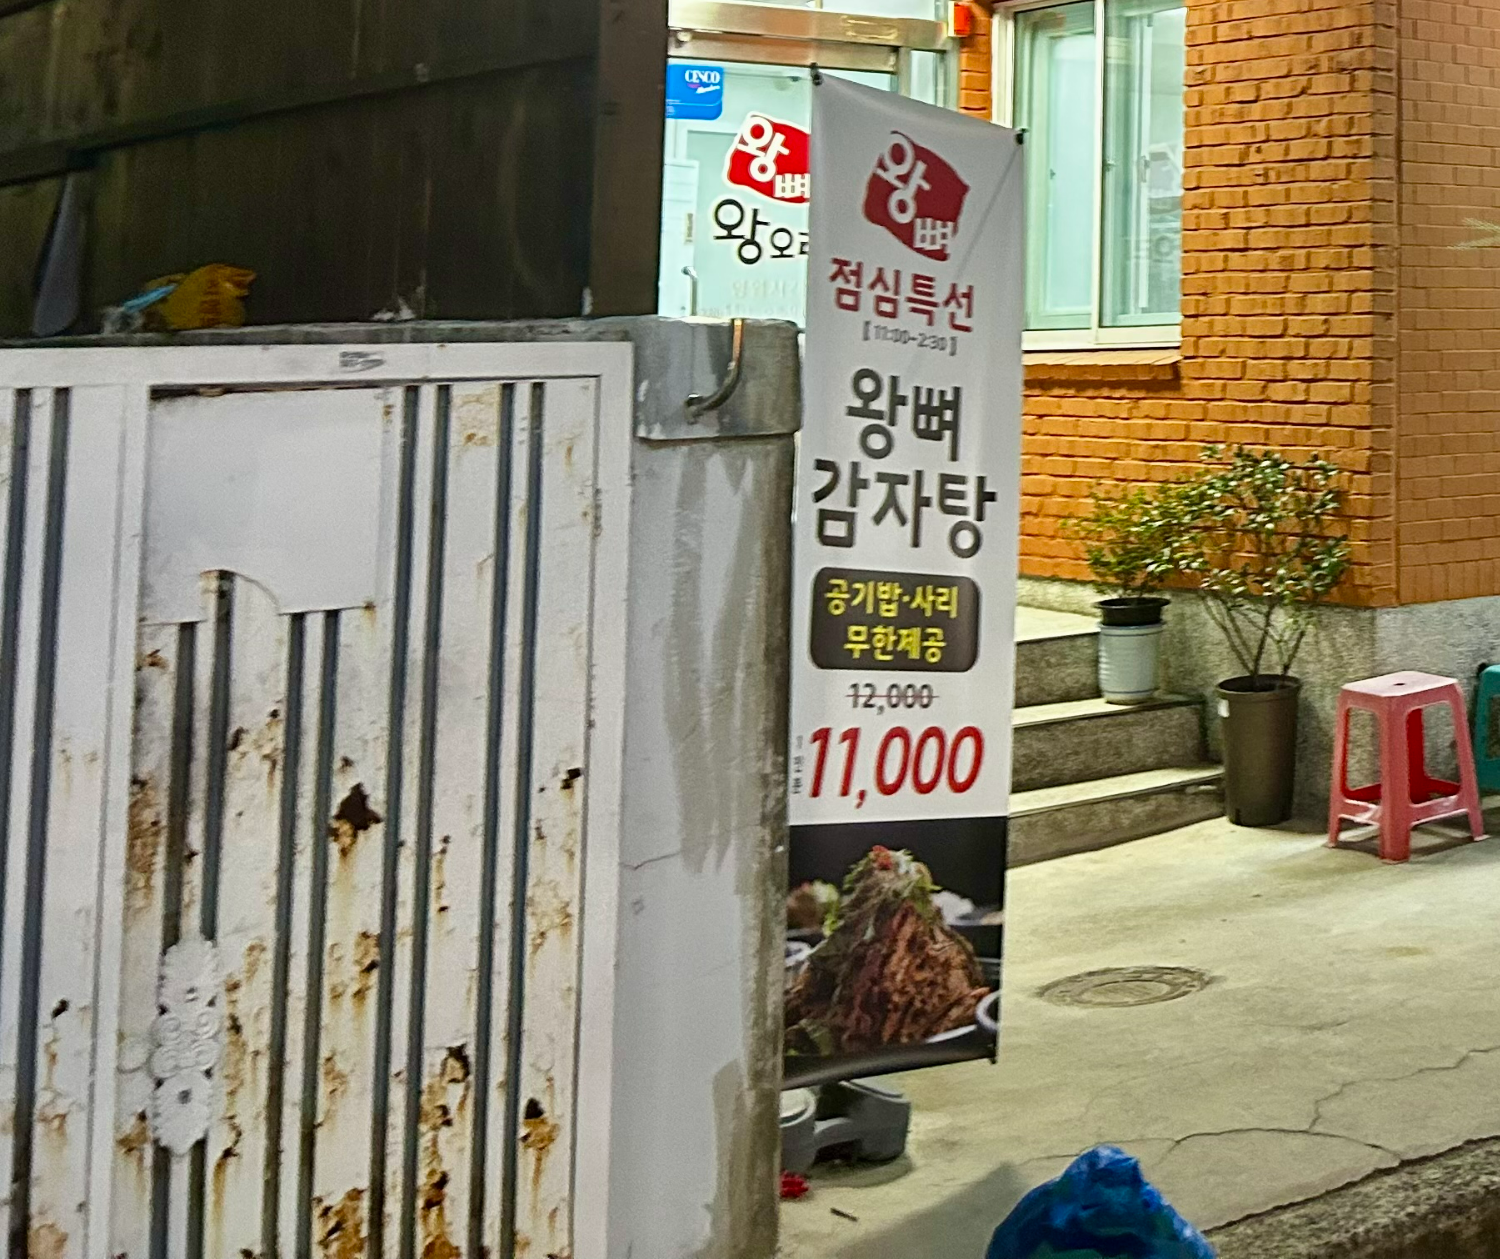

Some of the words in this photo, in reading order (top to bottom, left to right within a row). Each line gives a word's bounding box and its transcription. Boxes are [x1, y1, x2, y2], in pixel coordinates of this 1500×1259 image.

[829, 257, 974, 333] 점심특선
[846, 368, 963, 462] 왕뼈
[812, 458, 998, 559] 감자탕
[843, 625, 948, 664] 무한제공
[848, 683, 936, 715] 12,000
[808, 725, 985, 810] 11,000
